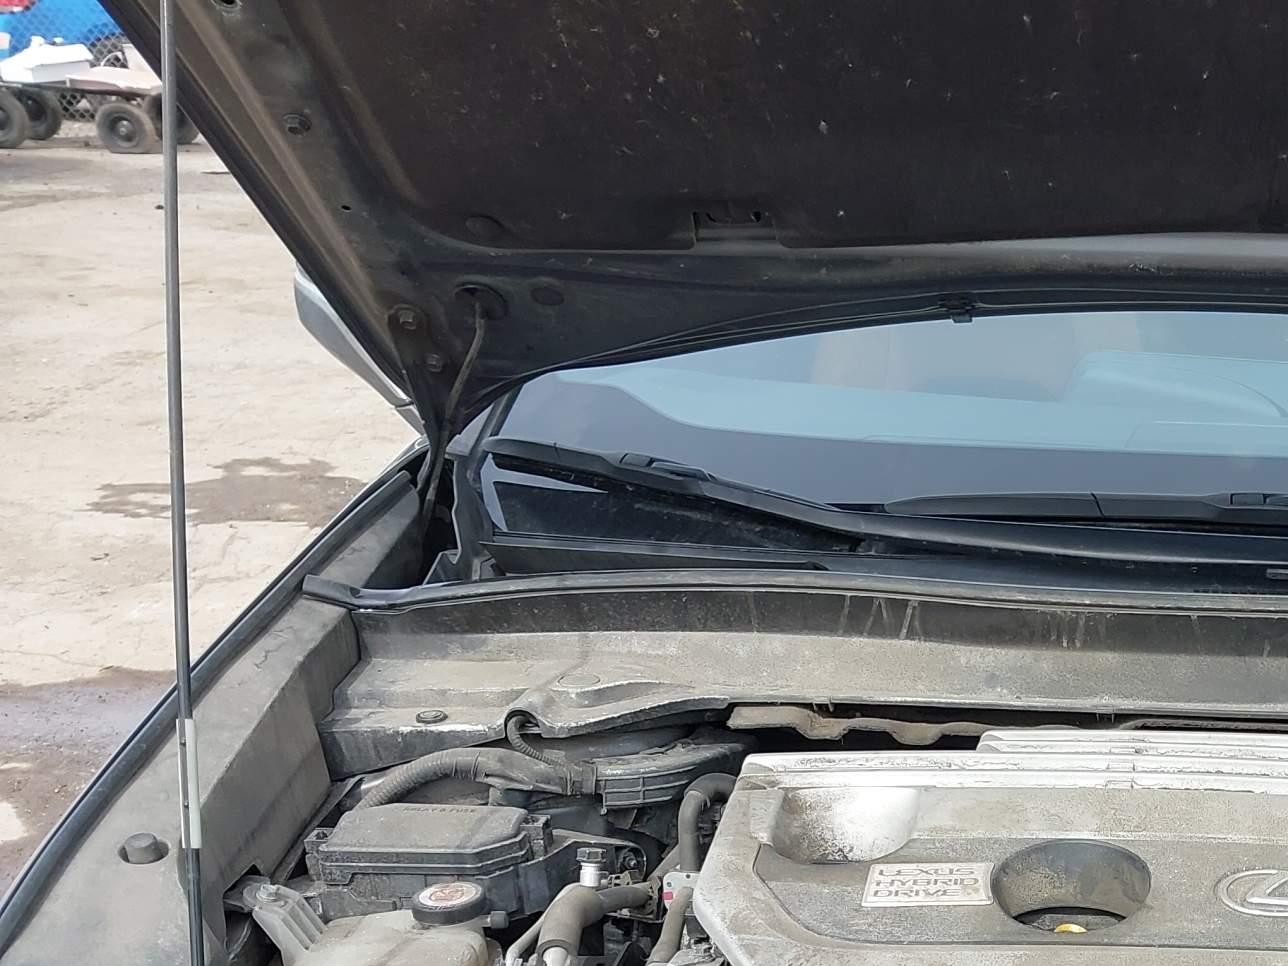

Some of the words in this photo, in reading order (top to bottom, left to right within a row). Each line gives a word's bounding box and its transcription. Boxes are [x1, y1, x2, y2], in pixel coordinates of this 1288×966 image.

[877, 867, 975, 876] LEXUS
[875, 878, 980, 887] HYBRID
[873, 888, 962, 898] DRIVE
